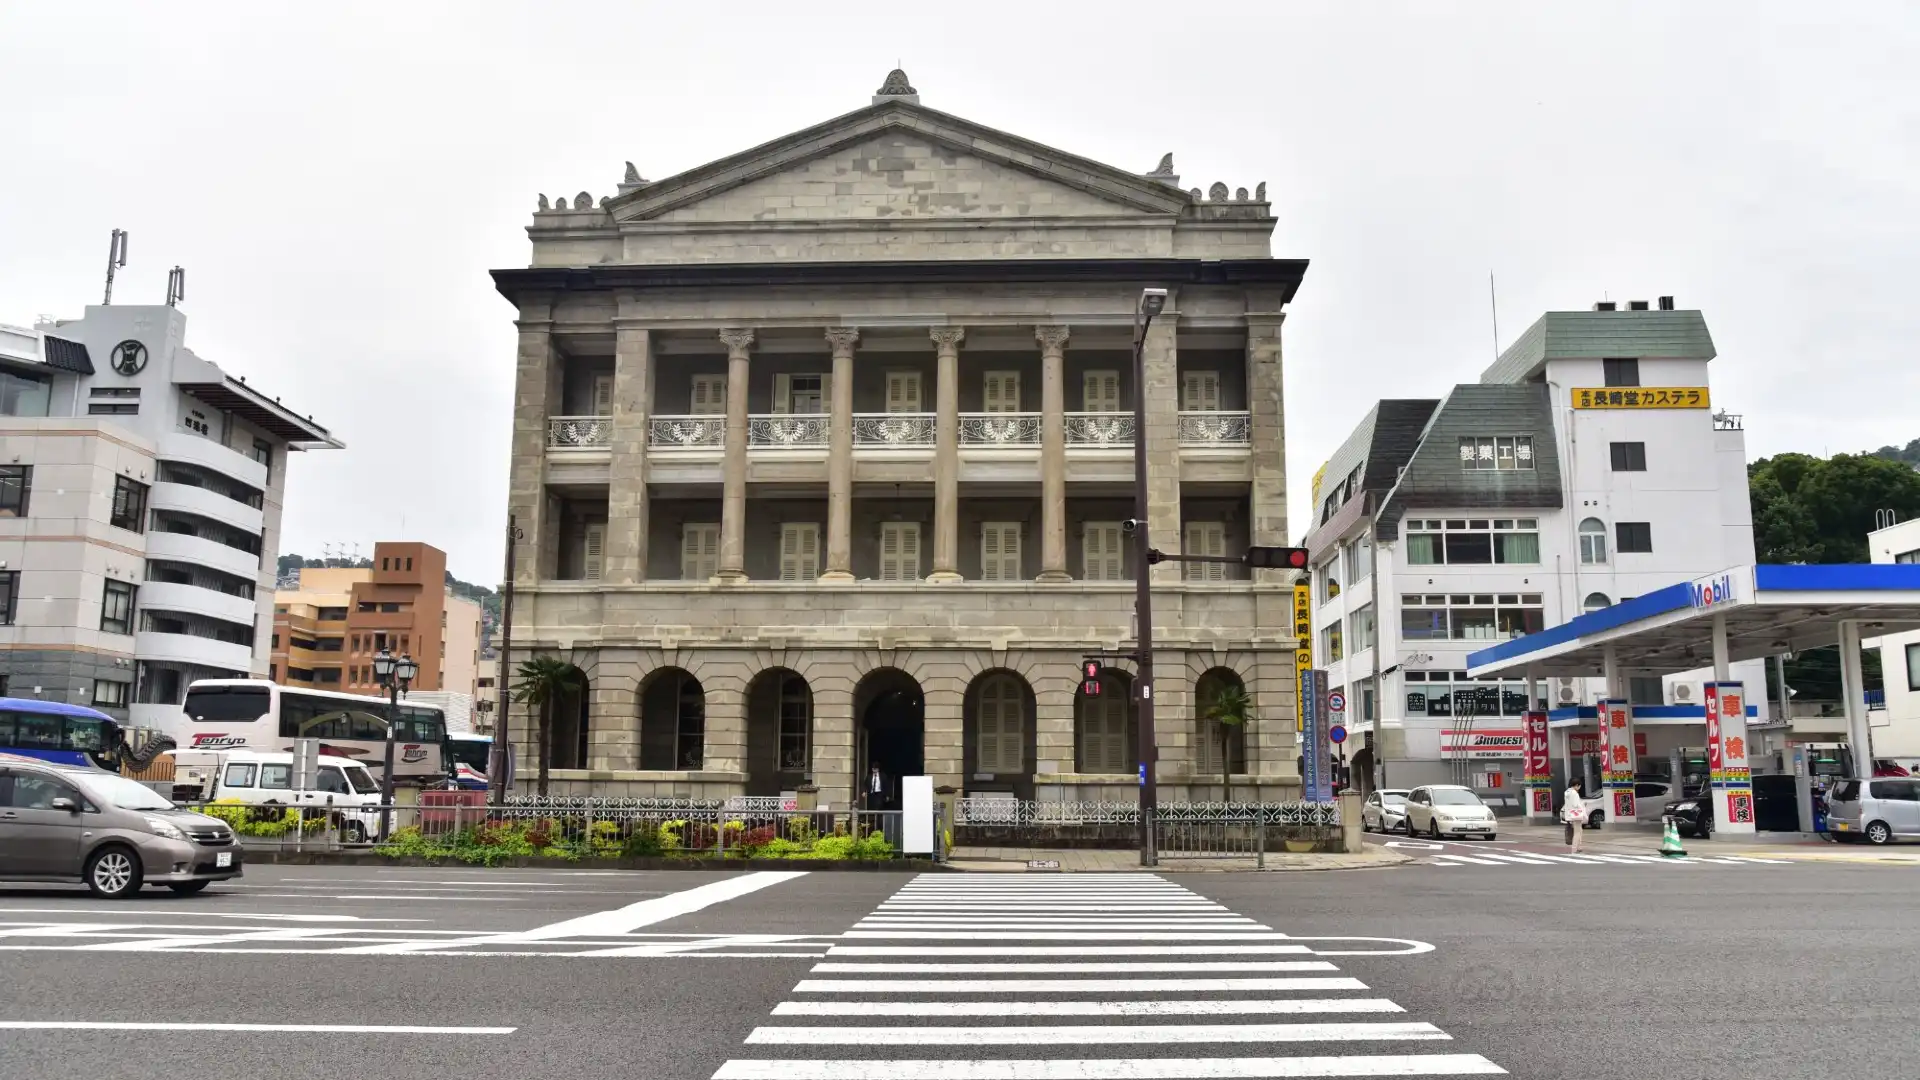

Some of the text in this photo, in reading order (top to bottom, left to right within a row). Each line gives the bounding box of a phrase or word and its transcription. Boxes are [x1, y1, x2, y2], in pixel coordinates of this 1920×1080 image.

[1580, 391, 1591, 407] 本店
[1460, 445, 1531, 461] 製菓工場
[1691, 574, 1731, 608] Mobil
[1475, 735, 1523, 746] BRIDGEST
[1530, 719, 1547, 770] セルフ
[1598, 710, 1608, 766] セルフ
[1611, 709, 1629, 765] 車検
[1706, 695, 1720, 762] セルフ
[1721, 695, 1744, 760] 車検
[1735, 797, 1749, 823] 車検
